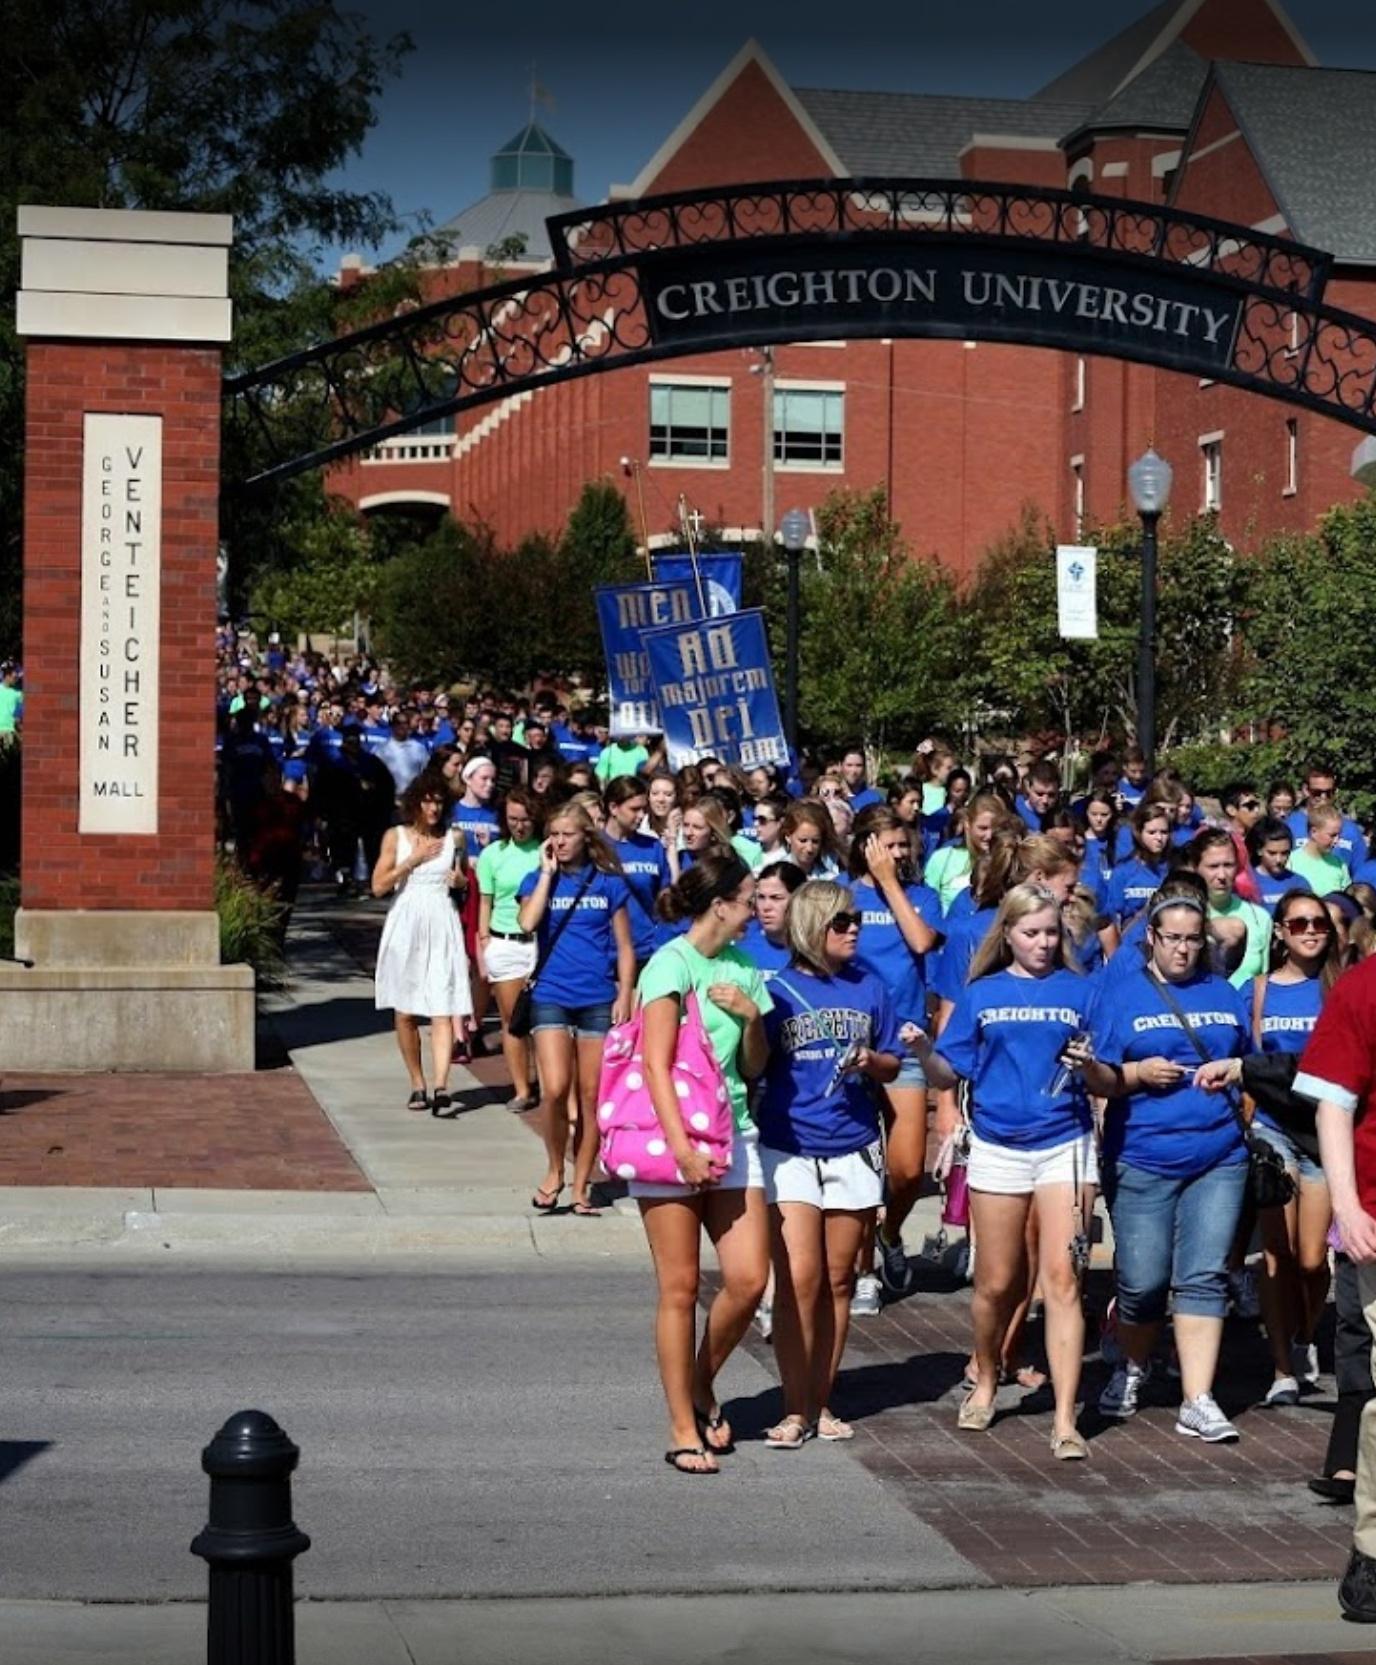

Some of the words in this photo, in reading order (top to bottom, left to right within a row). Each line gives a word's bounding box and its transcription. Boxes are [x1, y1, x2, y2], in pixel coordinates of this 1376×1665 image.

[656, 267, 937, 321] CREIGHTON
[962, 270, 1230, 343] UNIVERSITY
[99, 456, 113, 592] GEORGE
[122, 446, 143, 758] VENTEICHER
[97, 639, 111, 751] SUSAN
[93, 780, 144, 799] MALL
